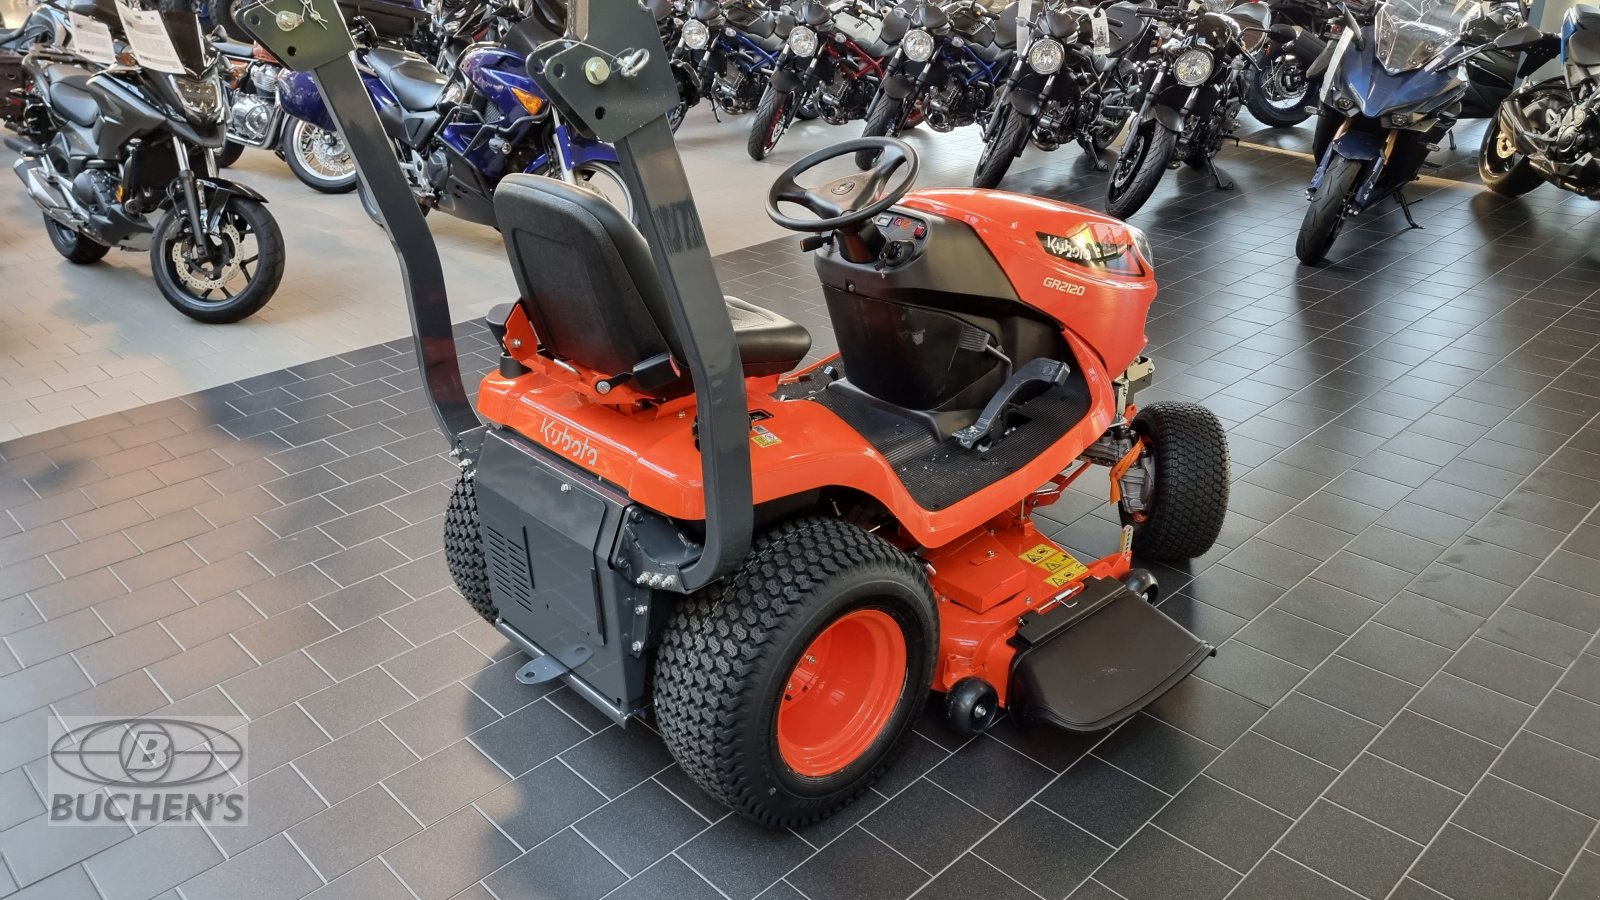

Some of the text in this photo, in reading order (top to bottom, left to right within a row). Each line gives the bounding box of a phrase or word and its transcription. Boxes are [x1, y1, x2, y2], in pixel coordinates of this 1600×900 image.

[1047, 236, 1091, 261] Kubota
[1042, 277, 1085, 296] GR2120
[540, 416, 598, 466] Kubota
